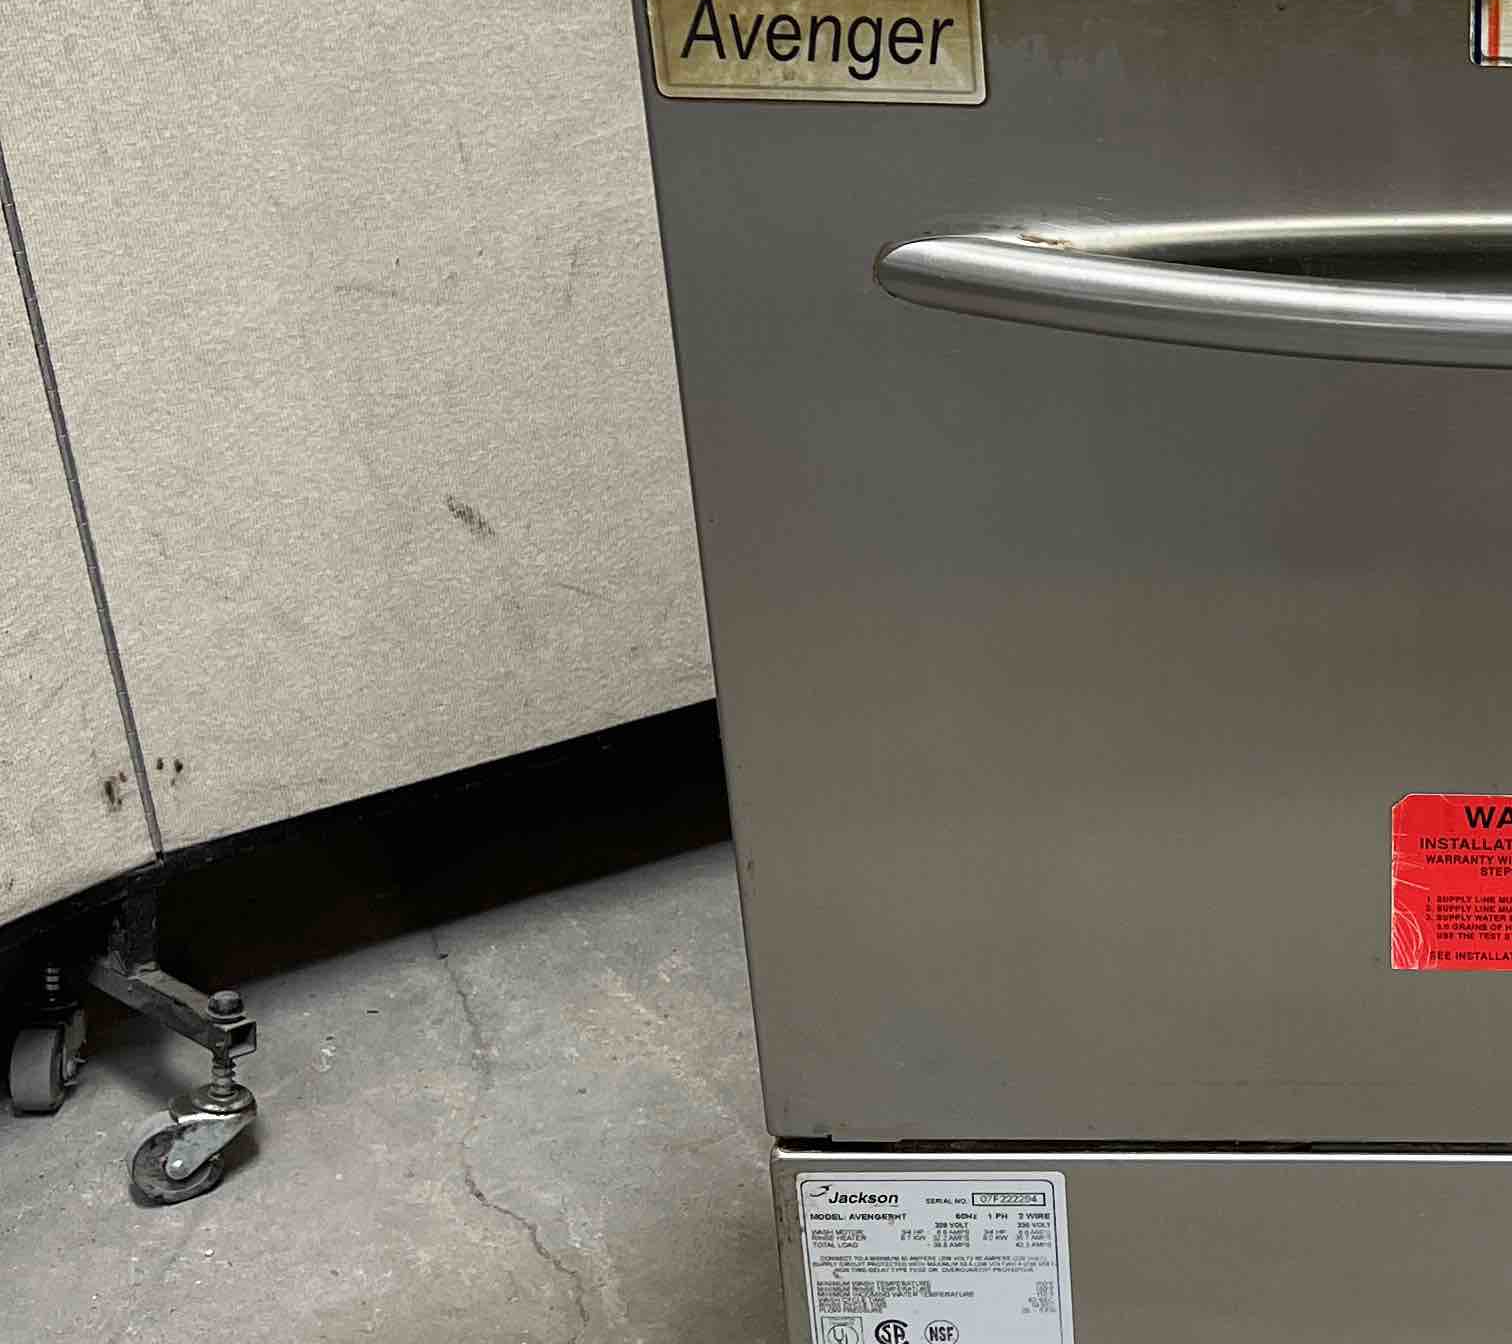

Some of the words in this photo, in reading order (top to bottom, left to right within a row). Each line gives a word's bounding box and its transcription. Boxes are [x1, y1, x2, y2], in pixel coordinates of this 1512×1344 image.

[1425, 855, 1496, 865] WARRANTY
[1475, 896, 1496, 904] LINE
[1430, 951, 1451, 960] SEE
[828, 1191, 899, 1204] Jackson
[929, 1326, 954, 1343] NSF
